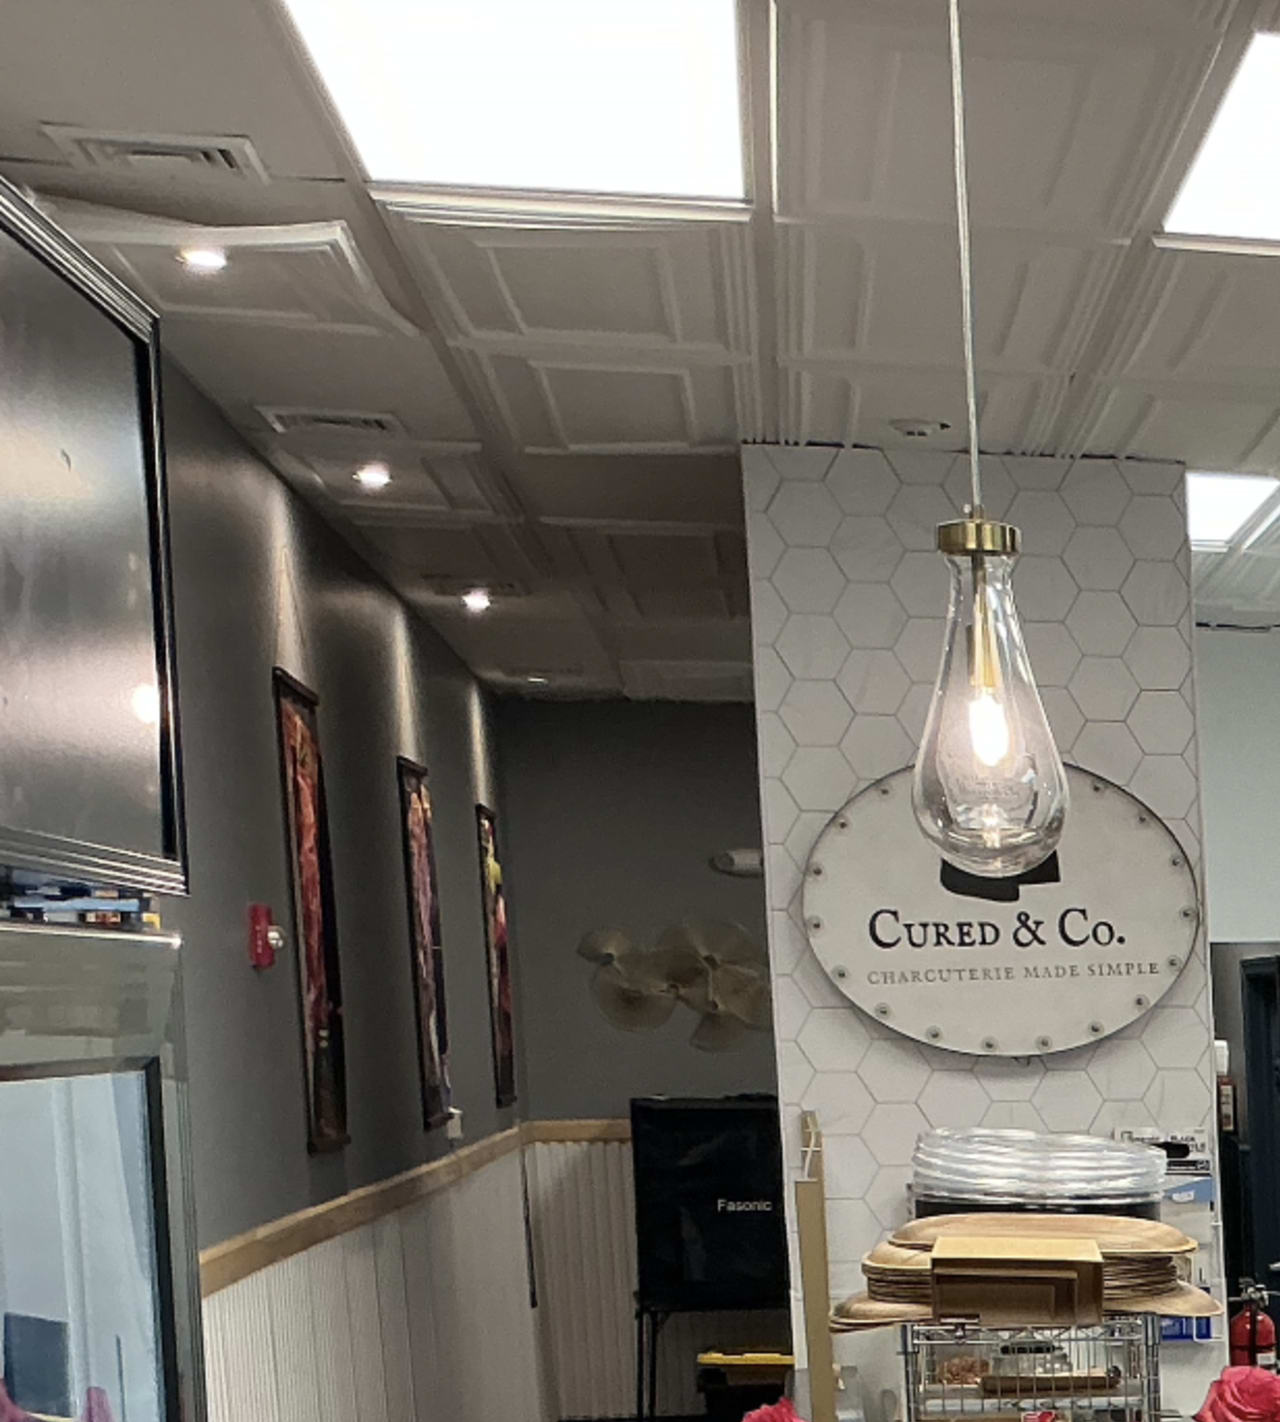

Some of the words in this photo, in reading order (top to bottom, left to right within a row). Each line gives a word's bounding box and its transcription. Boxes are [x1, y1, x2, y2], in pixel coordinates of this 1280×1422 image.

[1012, 910, 1047, 947] &
[867, 966, 1015, 986] CHARCUTERIE
[1024, 964, 1080, 980] MADE
[1087, 961, 1160, 977] SIMPLE
[717, 1198, 773, 1212] Fasonic
